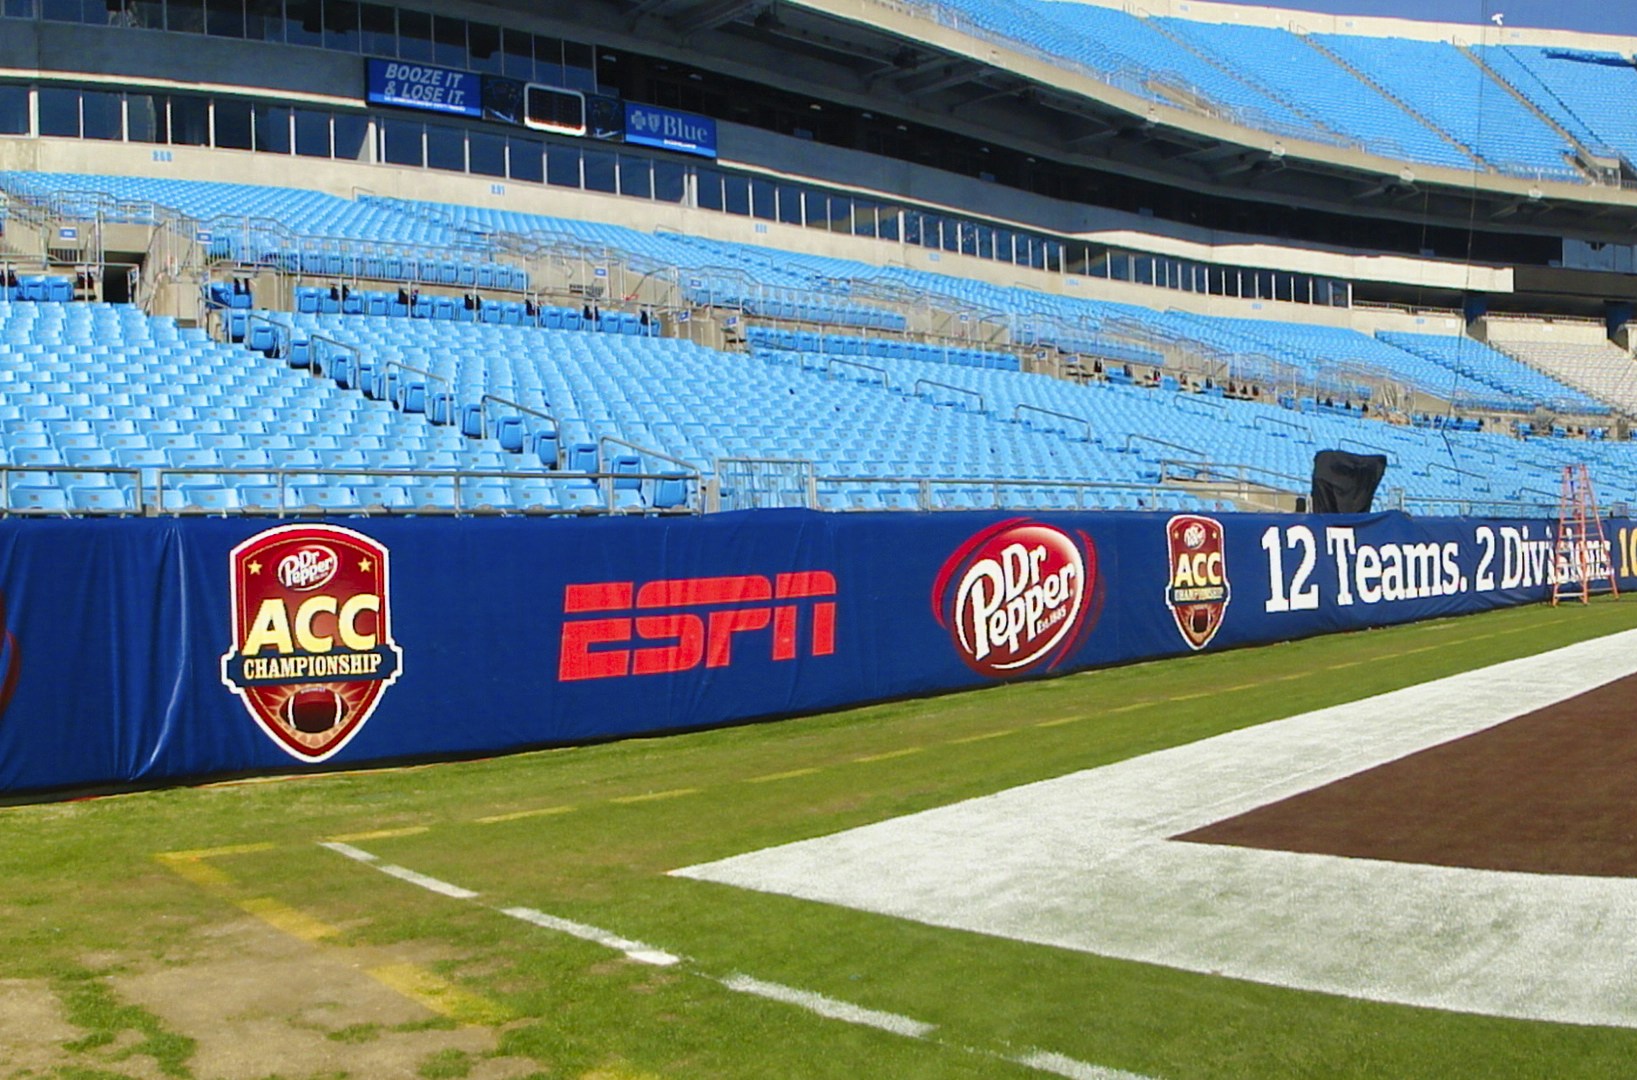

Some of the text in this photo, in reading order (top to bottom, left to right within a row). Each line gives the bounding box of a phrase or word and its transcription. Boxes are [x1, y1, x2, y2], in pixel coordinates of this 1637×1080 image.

[384, 80, 396, 97] &
[401, 82, 444, 103] LOSE
[447, 89, 464, 105] IT.
[385, 63, 463, 89] BOOZE IT
[663, 115, 708, 143] Blue
[278, 554, 334, 588] Pepper
[298, 549, 320, 569] Dr
[1001, 543, 1046, 600] Dr
[1174, 551, 1222, 587] ACC
[1261, 525, 1319, 613] 12
[1325, 526, 1467, 606] Teams.
[1475, 526, 1495, 593] 2
[1619, 526, 1629, 578] 1
[241, 593, 380, 656] ACC
[559, 571, 837, 682] ESPN
[956, 558, 1075, 662] Pepper
[243, 653, 382, 679] CHAMPIONSHIP
